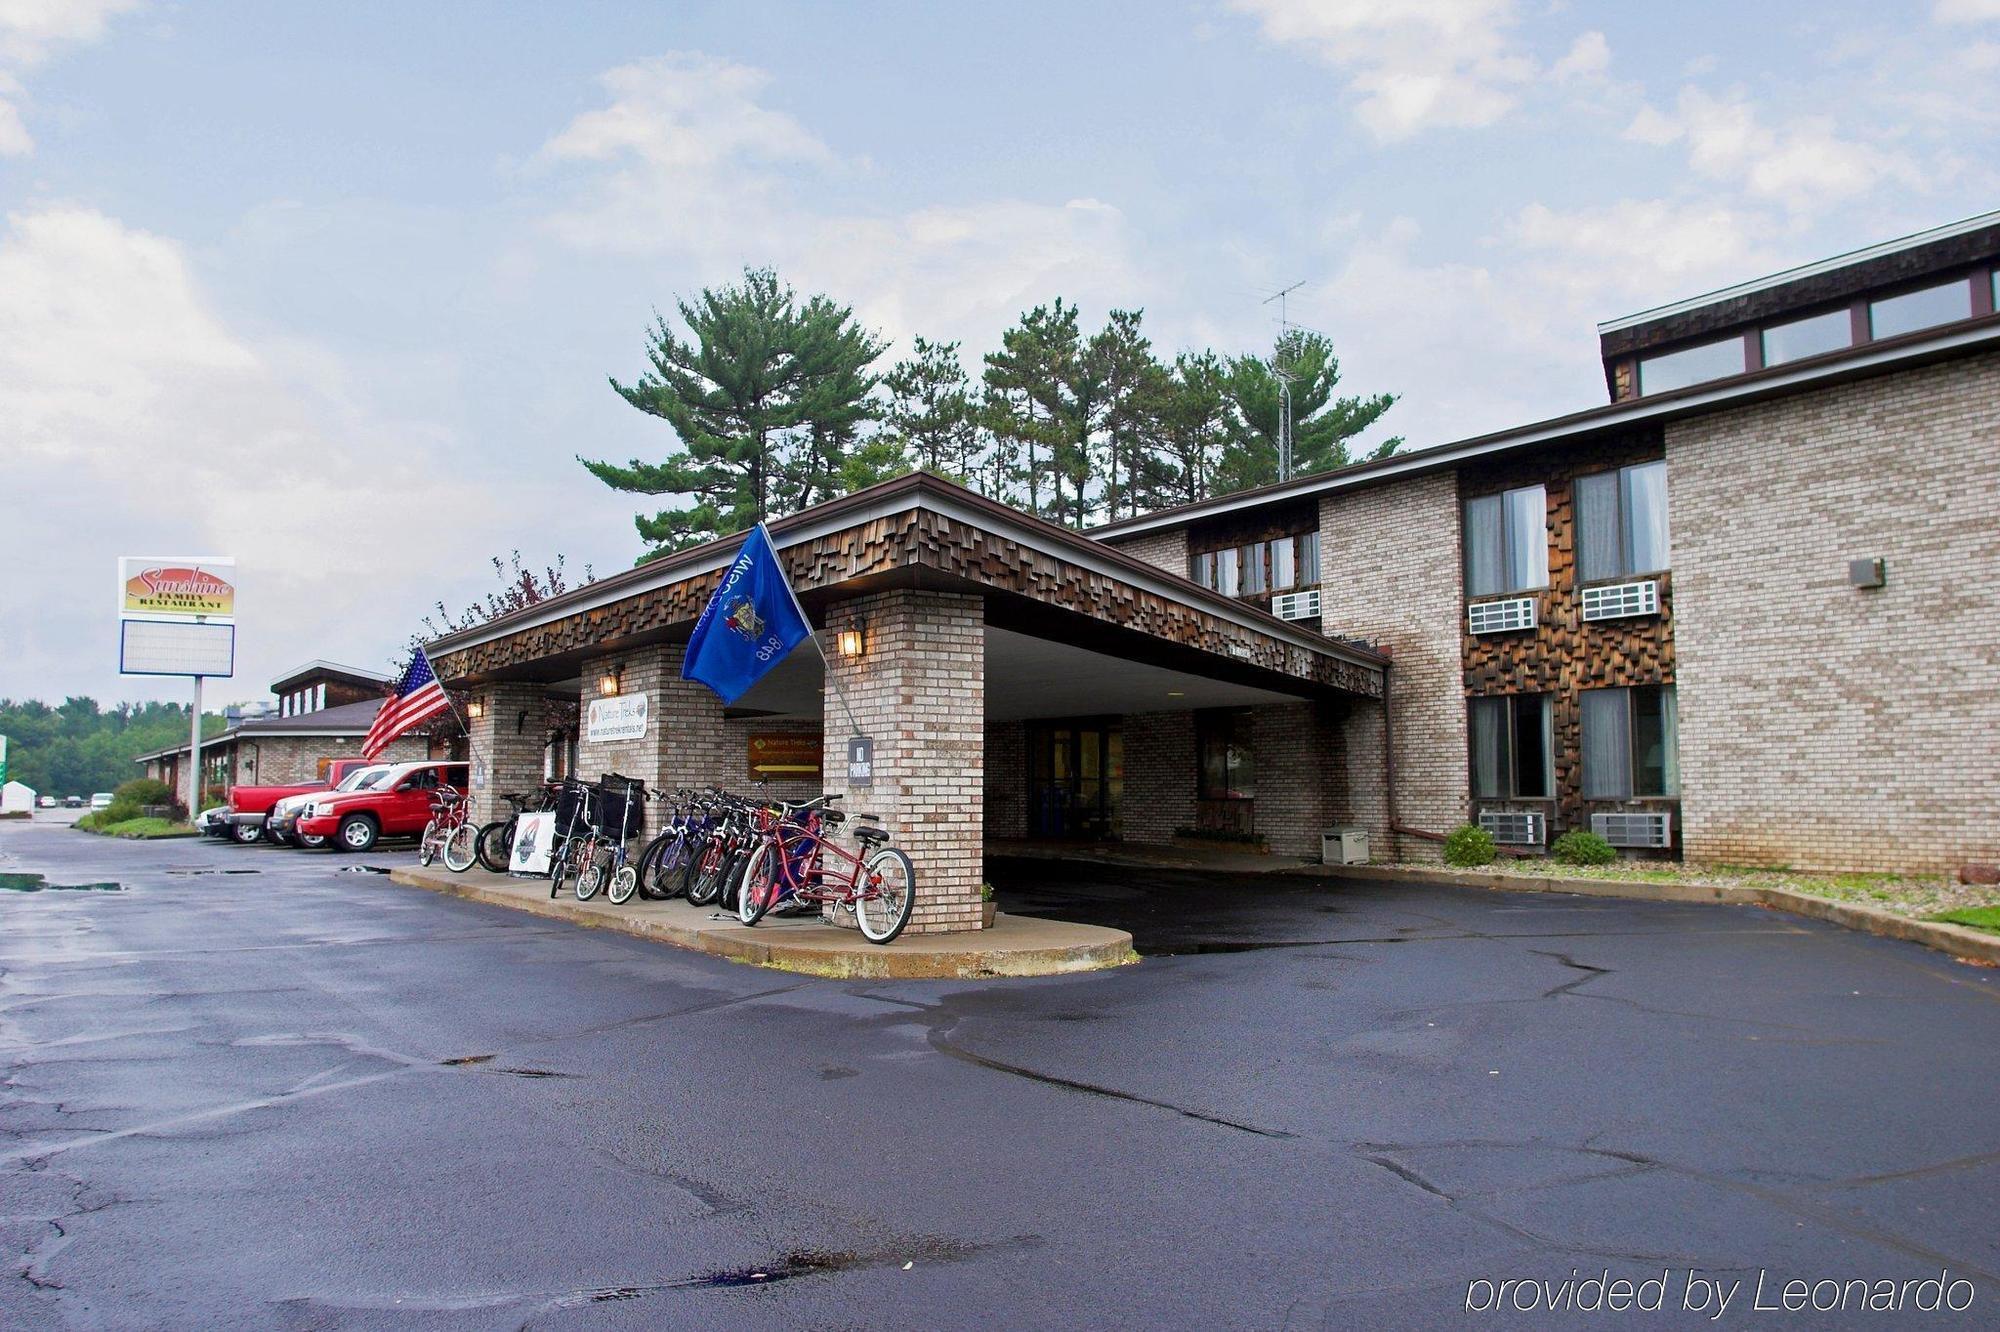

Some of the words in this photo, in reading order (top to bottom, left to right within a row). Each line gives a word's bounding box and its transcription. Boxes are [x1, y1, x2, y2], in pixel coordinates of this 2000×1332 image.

[129, 566, 229, 597] Sunshine
[158, 592, 203, 600] FAMILY
[139, 598, 221, 608] RESTAURANT
